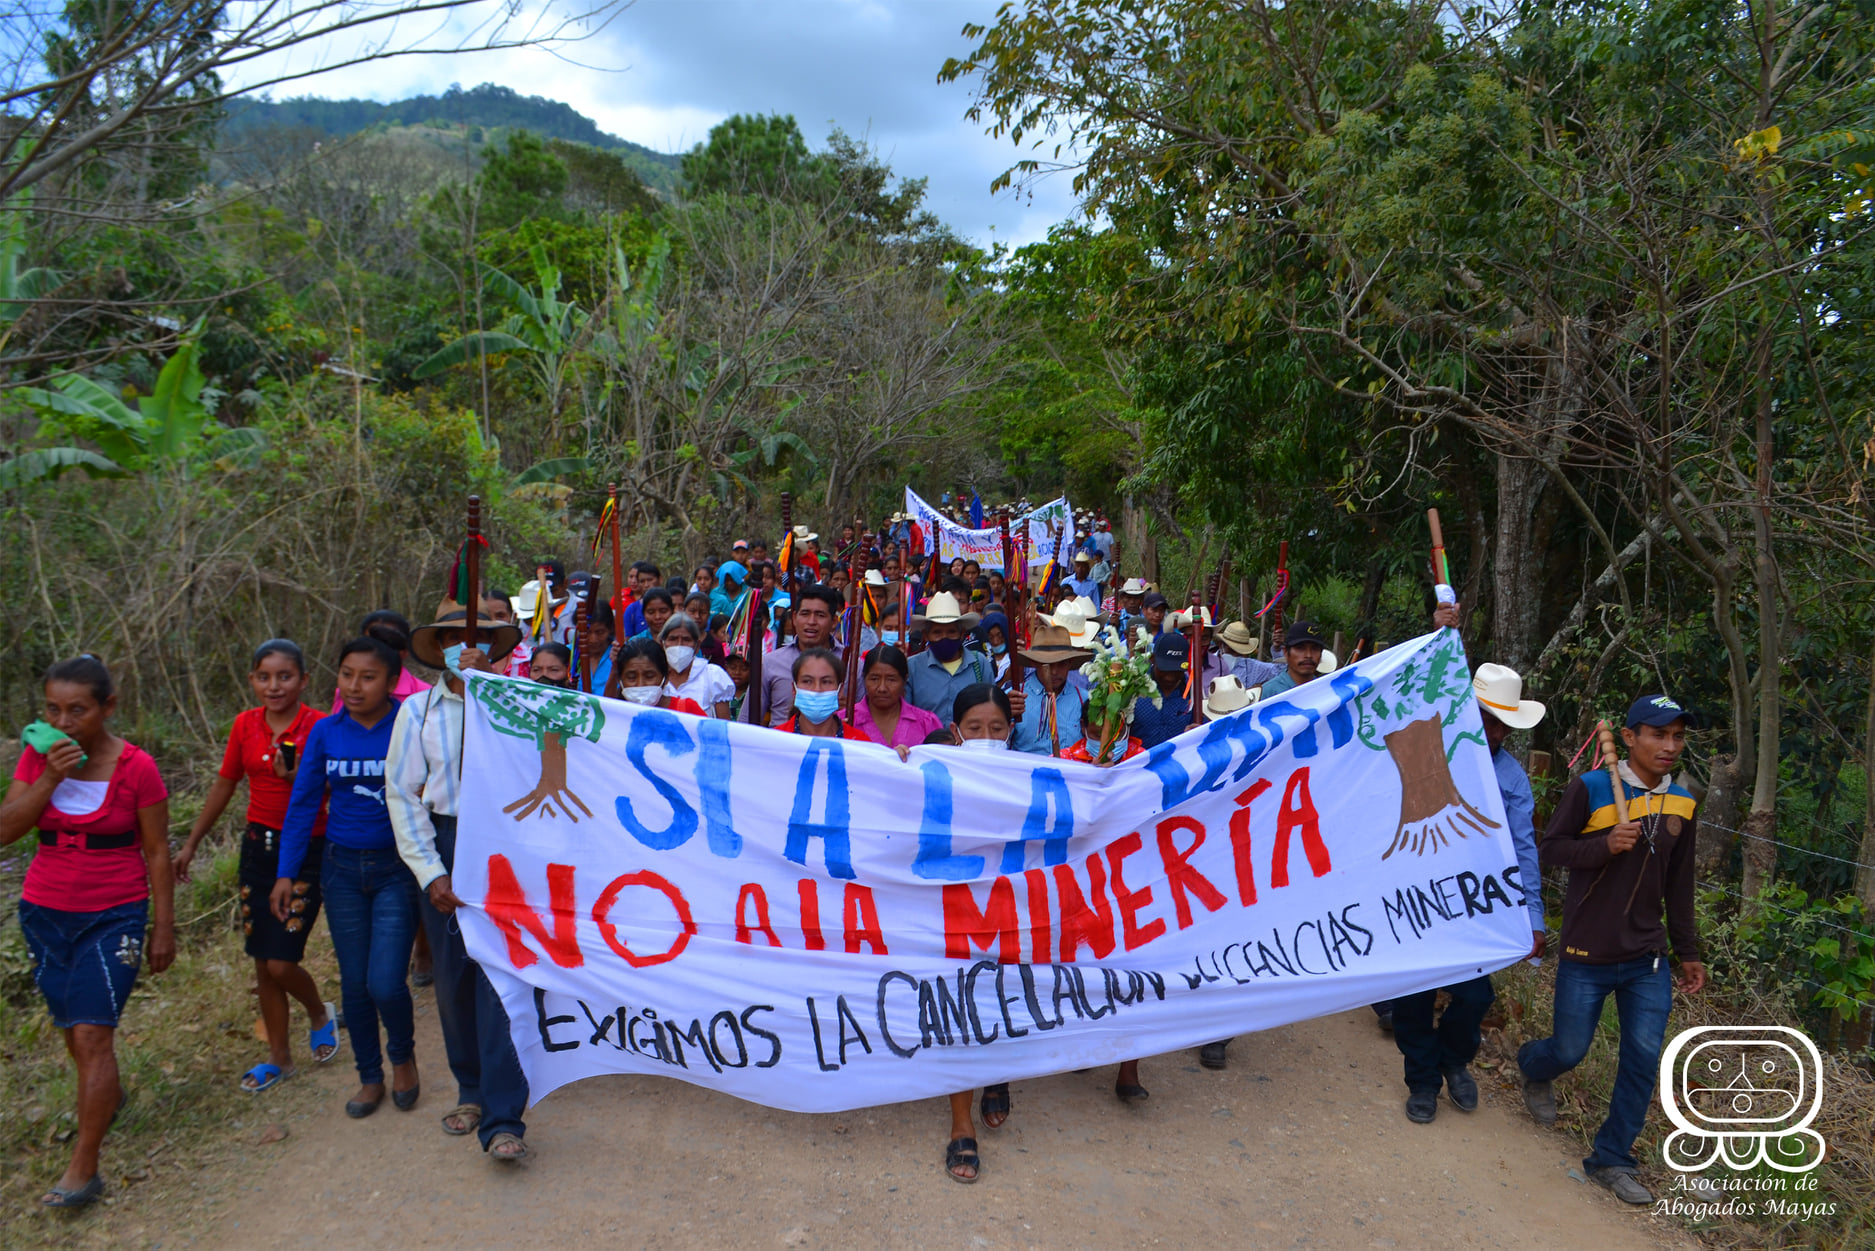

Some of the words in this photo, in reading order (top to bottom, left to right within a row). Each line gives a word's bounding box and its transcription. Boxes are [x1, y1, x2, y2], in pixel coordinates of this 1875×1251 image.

[326, 759, 387, 778] PUM
[614, 709, 743, 859] SI
[783, 738, 858, 881] A
[911, 759, 1075, 881] LA
[484, 853, 698, 969] NO
[735, 882, 783, 948] A
[942, 766, 1332, 964] MINERÍA
[806, 995, 873, 1071] LA
[1382, 865, 1527, 944] MINERAS
